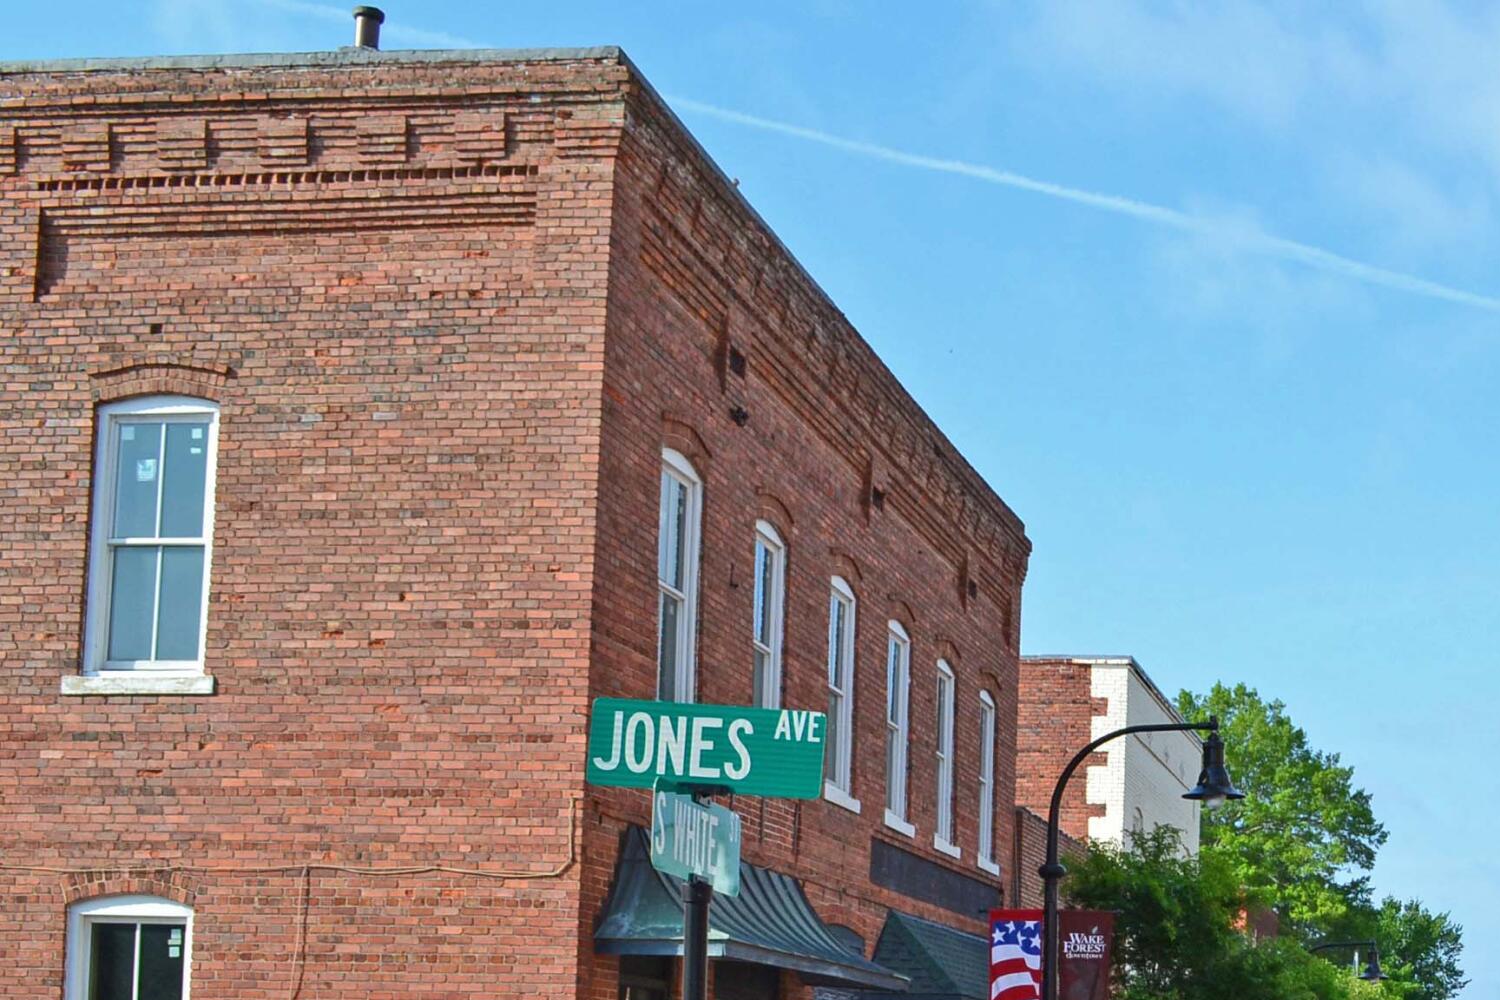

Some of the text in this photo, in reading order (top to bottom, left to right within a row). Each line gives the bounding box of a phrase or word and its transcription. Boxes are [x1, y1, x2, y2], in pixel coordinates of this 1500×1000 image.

[593, 709, 822, 780] JONES AVE
[656, 791, 667, 855] S
[673, 798, 719, 876] WHITE
[1063, 941, 1106, 953] FOREST
[1069, 933, 1104, 945] WAKE
